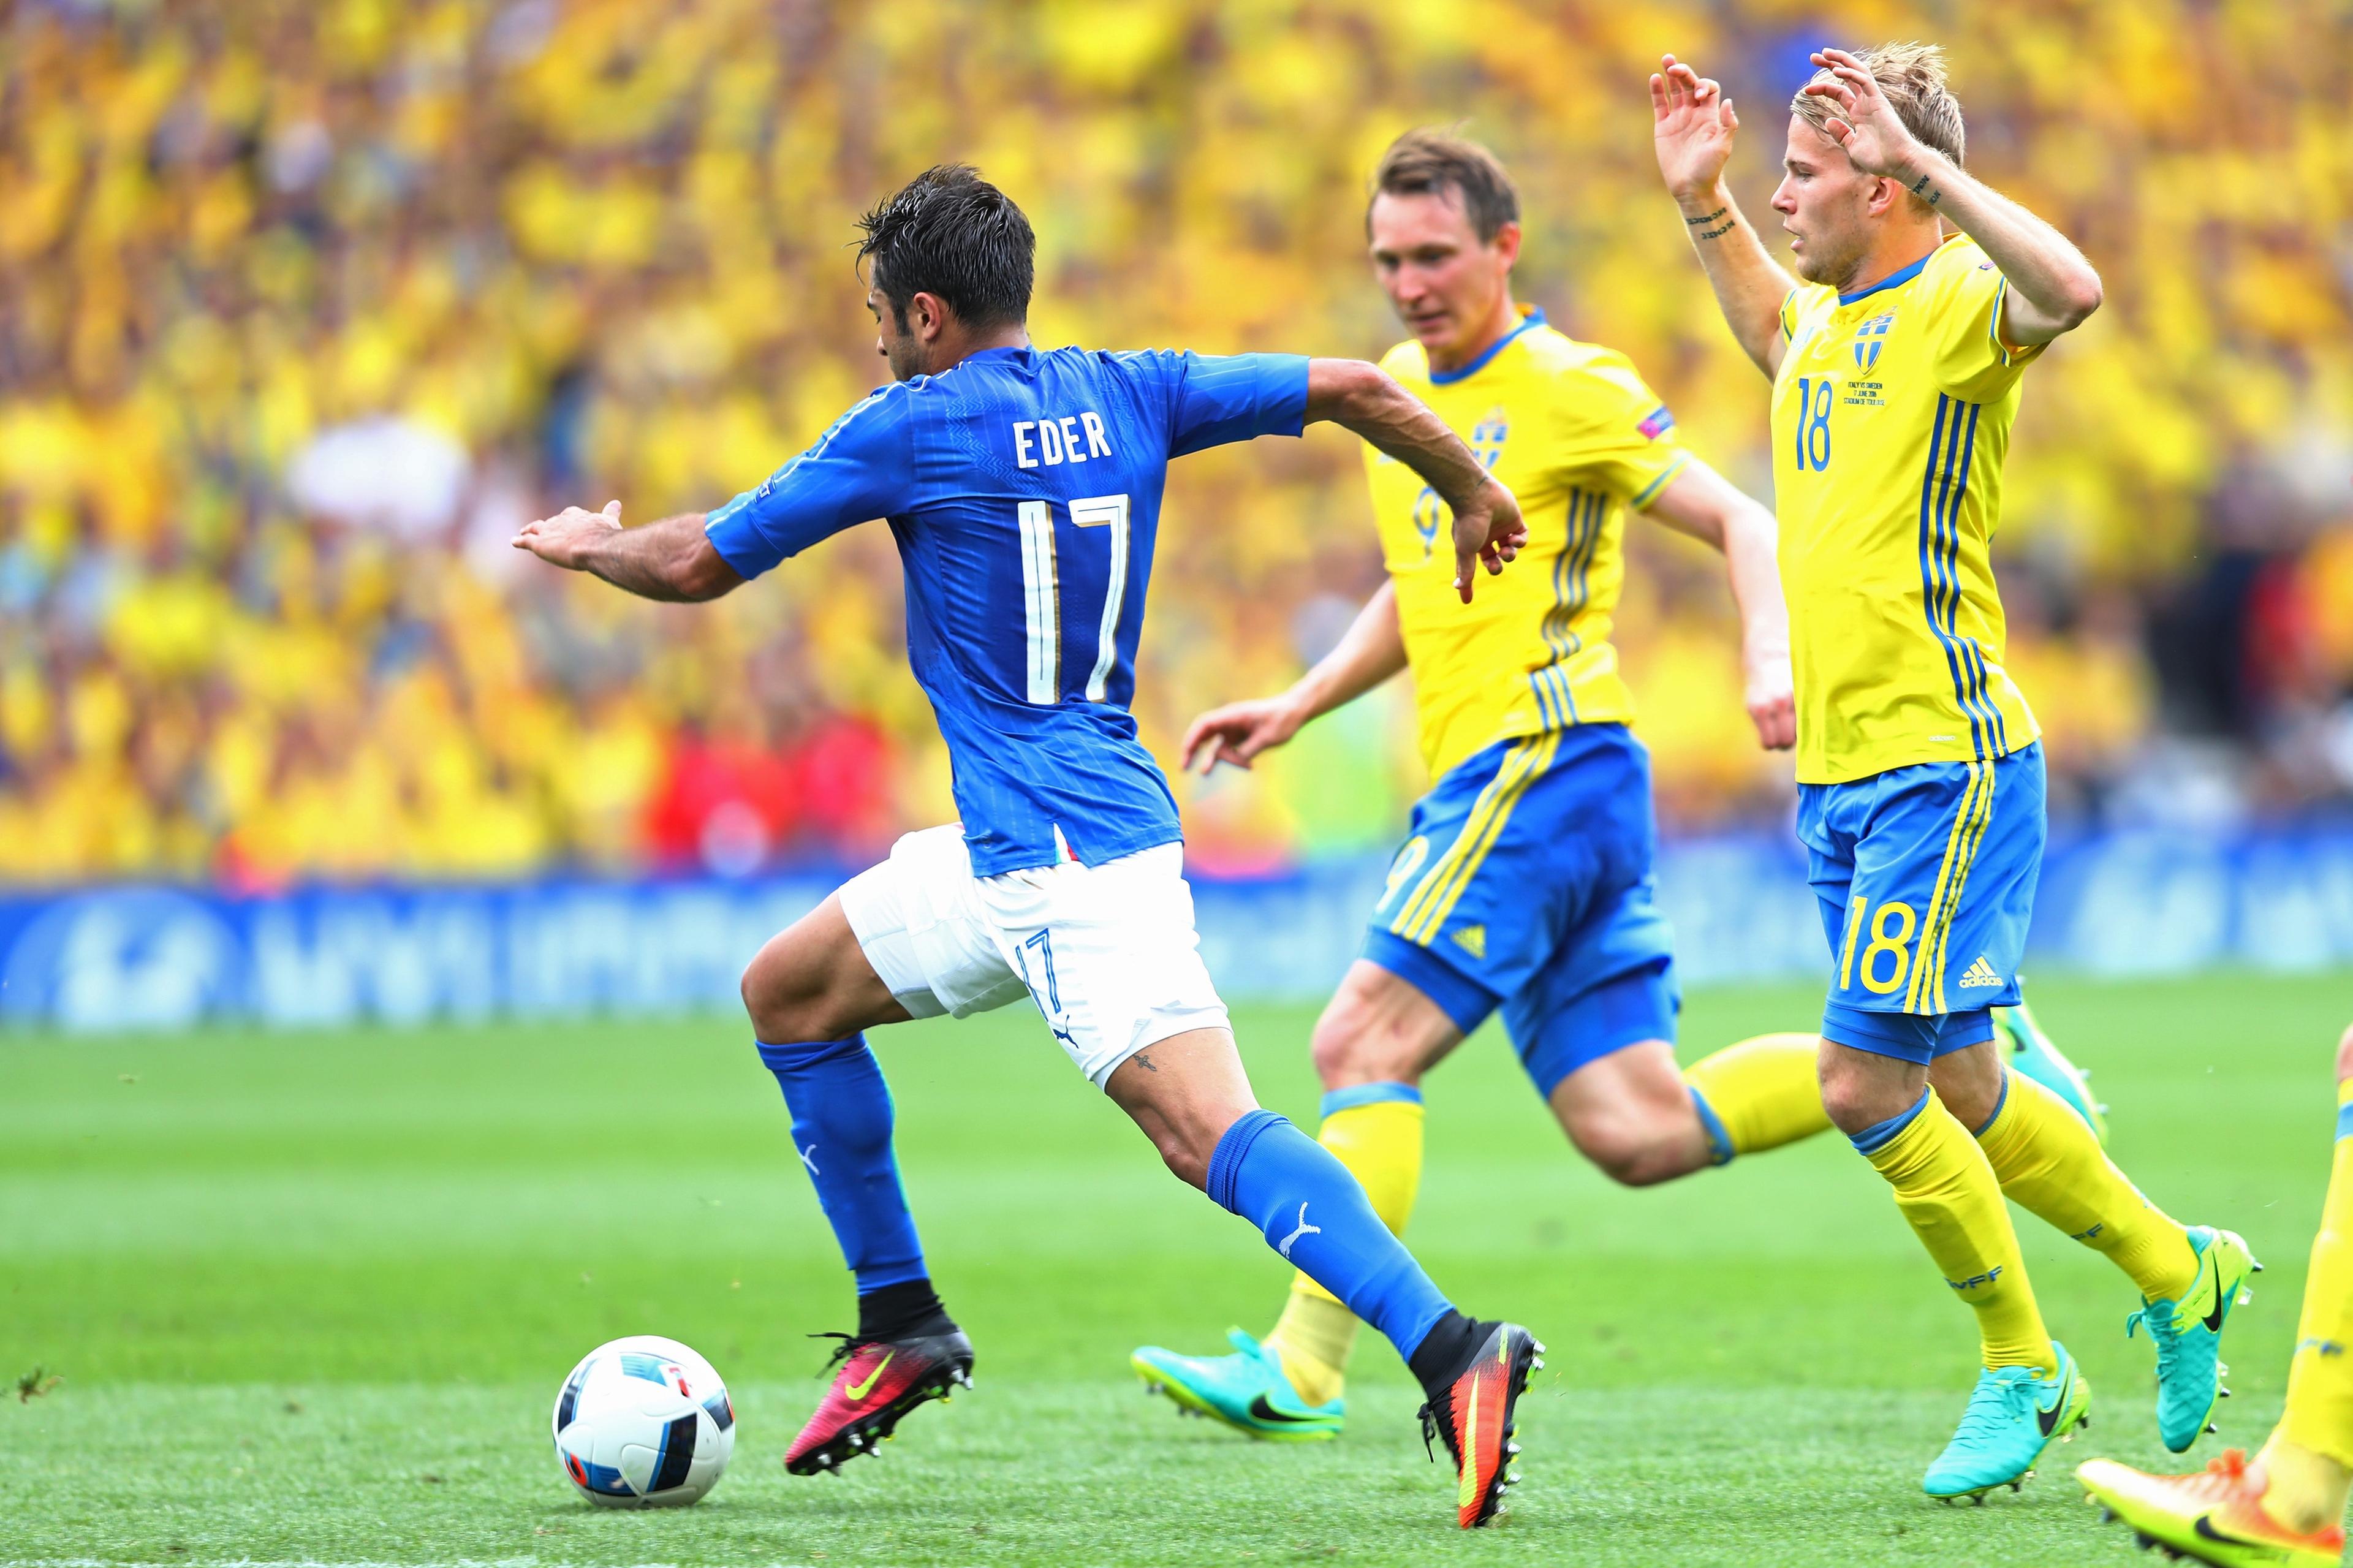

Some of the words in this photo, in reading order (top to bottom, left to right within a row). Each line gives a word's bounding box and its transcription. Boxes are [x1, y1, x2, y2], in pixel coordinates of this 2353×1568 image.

[1012, 411, 1112, 469] EDER
[1796, 377, 1833, 472] 18
[1413, 485, 1441, 558] 9
[1017, 493, 1132, 705] 17
[1375, 835, 1430, 914] 9
[1015, 927, 1062, 1023] 17
[1840, 895, 1917, 994] 18
[1958, 975, 2004, 989] adidas
